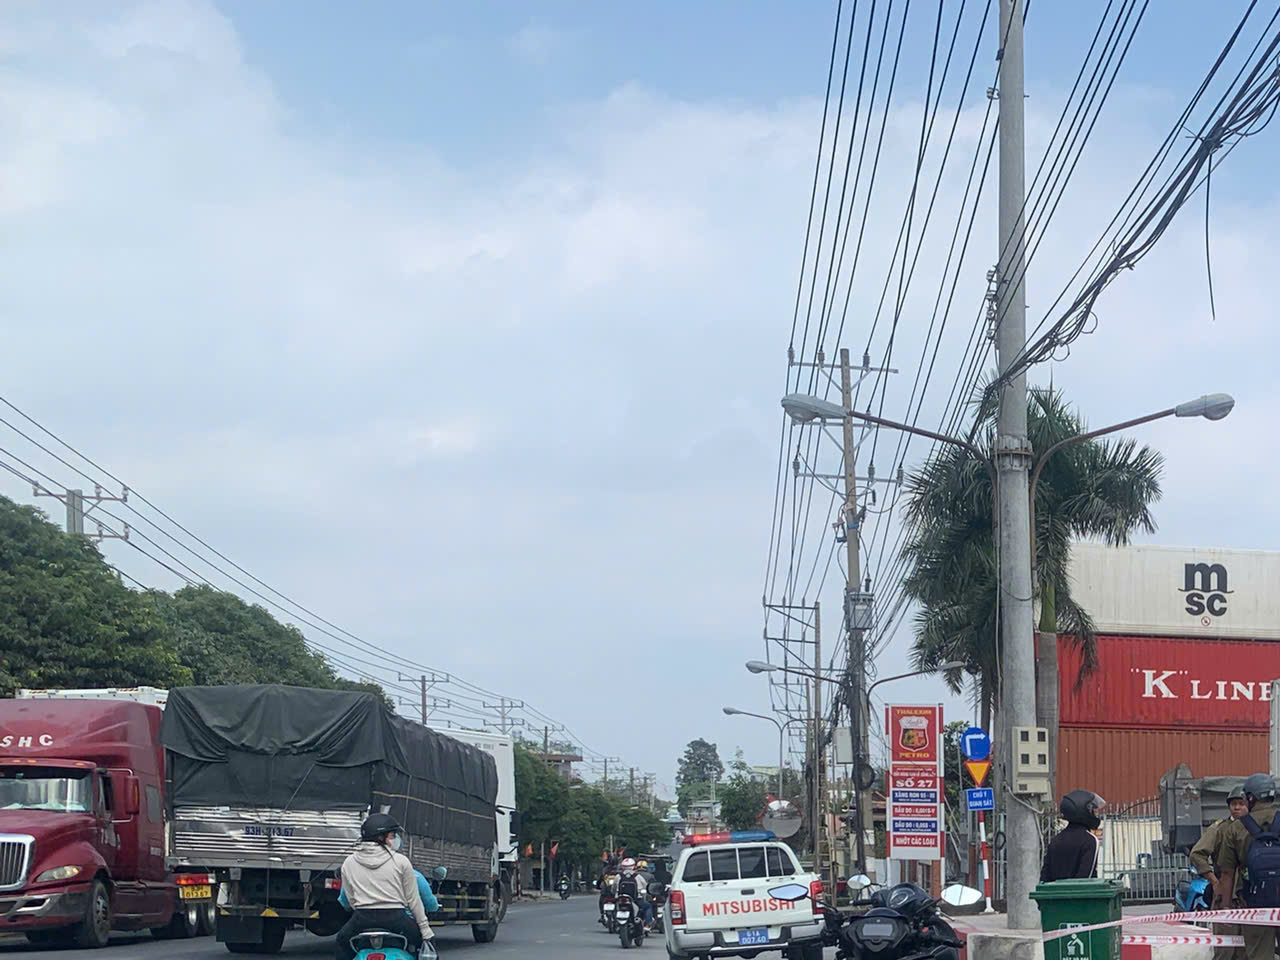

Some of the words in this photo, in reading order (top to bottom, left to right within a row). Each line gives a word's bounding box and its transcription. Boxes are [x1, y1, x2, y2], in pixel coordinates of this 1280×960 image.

[1191, 680, 1272, 702] LINE
[895, 776, 915, 788] SỐ
[917, 779, 933, 788] 27
[702, 898, 795, 917] MITSUBISHI
